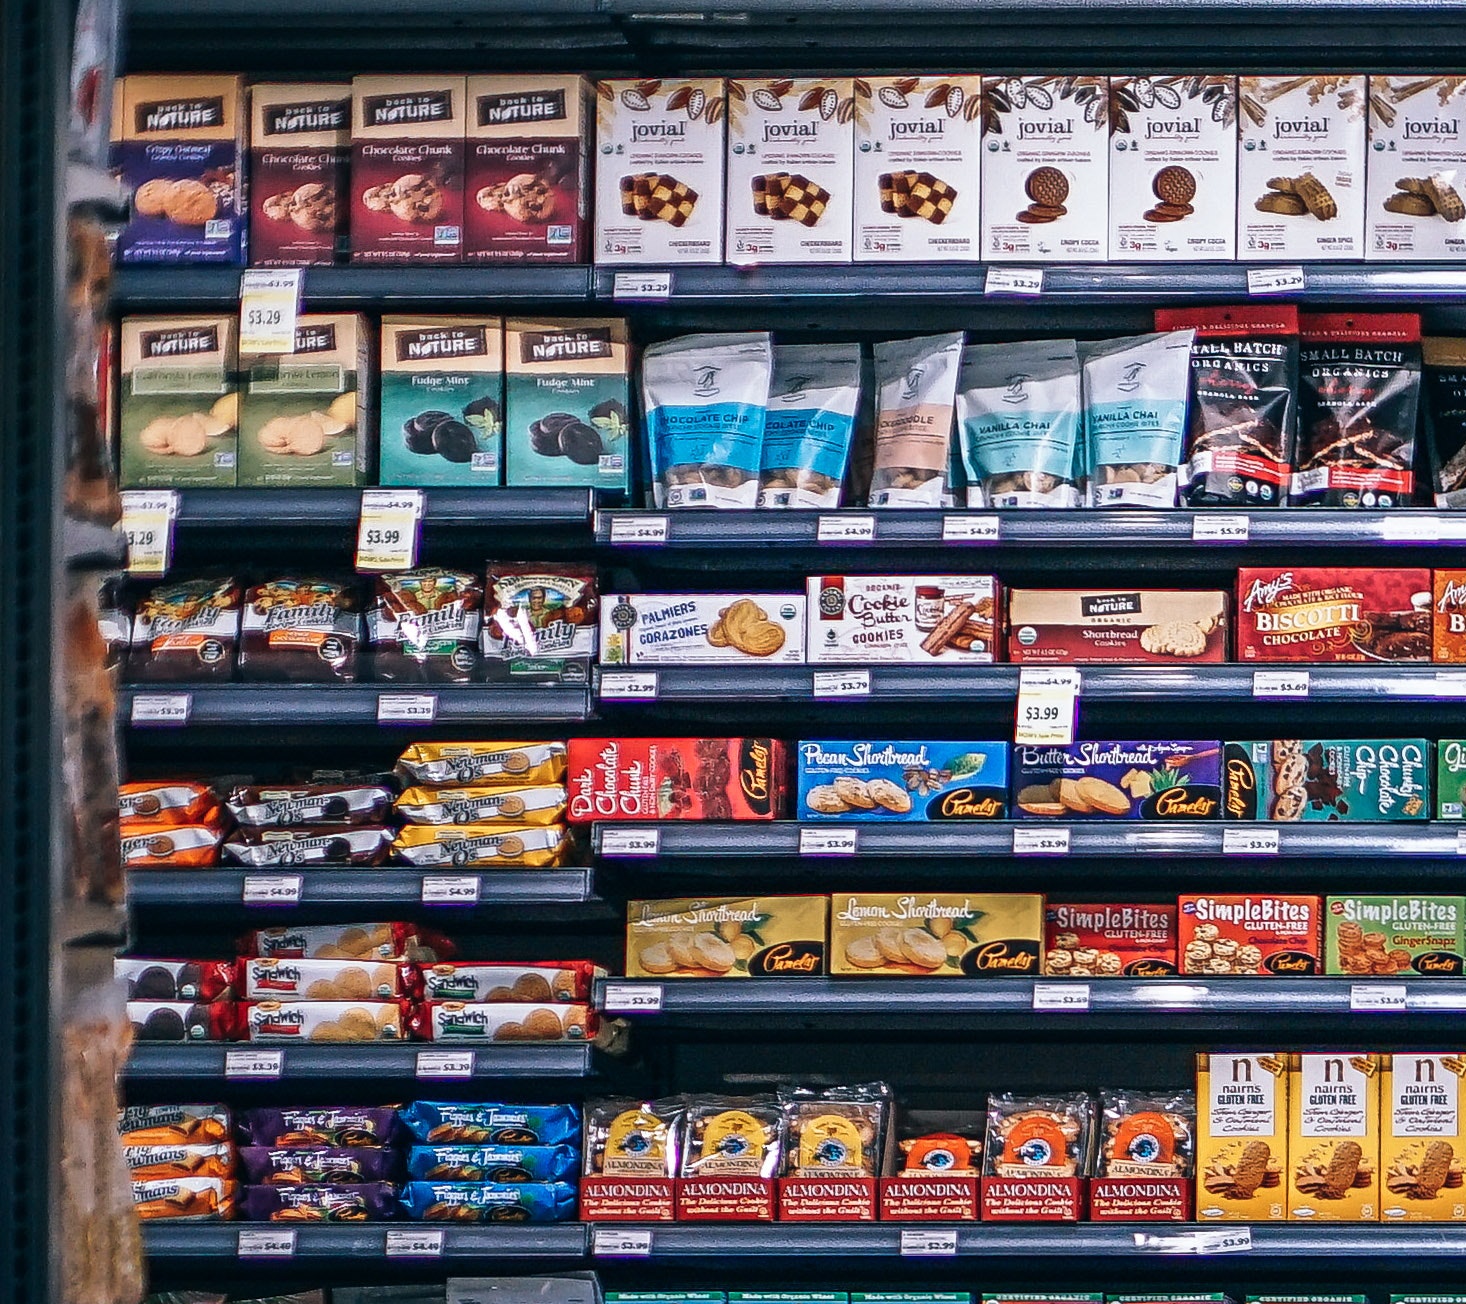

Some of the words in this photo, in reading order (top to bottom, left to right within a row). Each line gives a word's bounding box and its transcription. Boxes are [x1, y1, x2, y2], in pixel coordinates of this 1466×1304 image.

[630, 118, 685, 142] jovial
[1016, 117, 1072, 141] jovial
[1273, 116, 1329, 140] jovial
[362, 144, 409, 156] Chocolate
[411, 144, 452, 156] Chunk
[248, 308, 281, 326] $3.29
[1300, 350, 1339, 363] SMALL
[1342, 349, 1404, 363] BATCH
[411, 375, 442, 388] Fudge
[445, 374, 470, 385] Mint
[1312, 368, 1390, 378] ORGANICS
[978, 420, 1020, 433] VANILLA
[1023, 420, 1051, 432] CHAI
[366, 529, 400, 546] $3.99
[1246, 571, 1293, 612] Amy's
[641, 600, 697, 625] PALMIERS
[848, 595, 909, 616] Cookie
[861, 611, 913, 629] Butter
[1256, 603, 1360, 631] BISCOTTI
[639, 623, 709, 647] CORAZONES
[852, 628, 904, 643] COOKIES
[1082, 629, 1139, 640] Shortbread
[1263, 627, 1342, 646] CHOCOLATE
[627, 683, 655, 693] $2.99
[1026, 706, 1059, 722] $3.99
[802, 744, 846, 766] Pecan
[845, 743, 930, 768] Shortbread
[598, 742, 616, 814] Chocolate
[572, 769, 593, 817] Dark
[620, 760, 641, 815] Chunk
[840, 898, 892, 921] Lemon
[895, 897, 976, 921] Shortbread
[1195, 898, 1310, 923] SimpleBites
[1244, 921, 1309, 932] GLUTEN-FREE
[1222, 1083, 1262, 1094] nairns
[1217, 1094, 1243, 1105] GLUTEN
[1245, 1094, 1265, 1105] FREE
[681, 1182, 768, 1196] ALMONDINA
